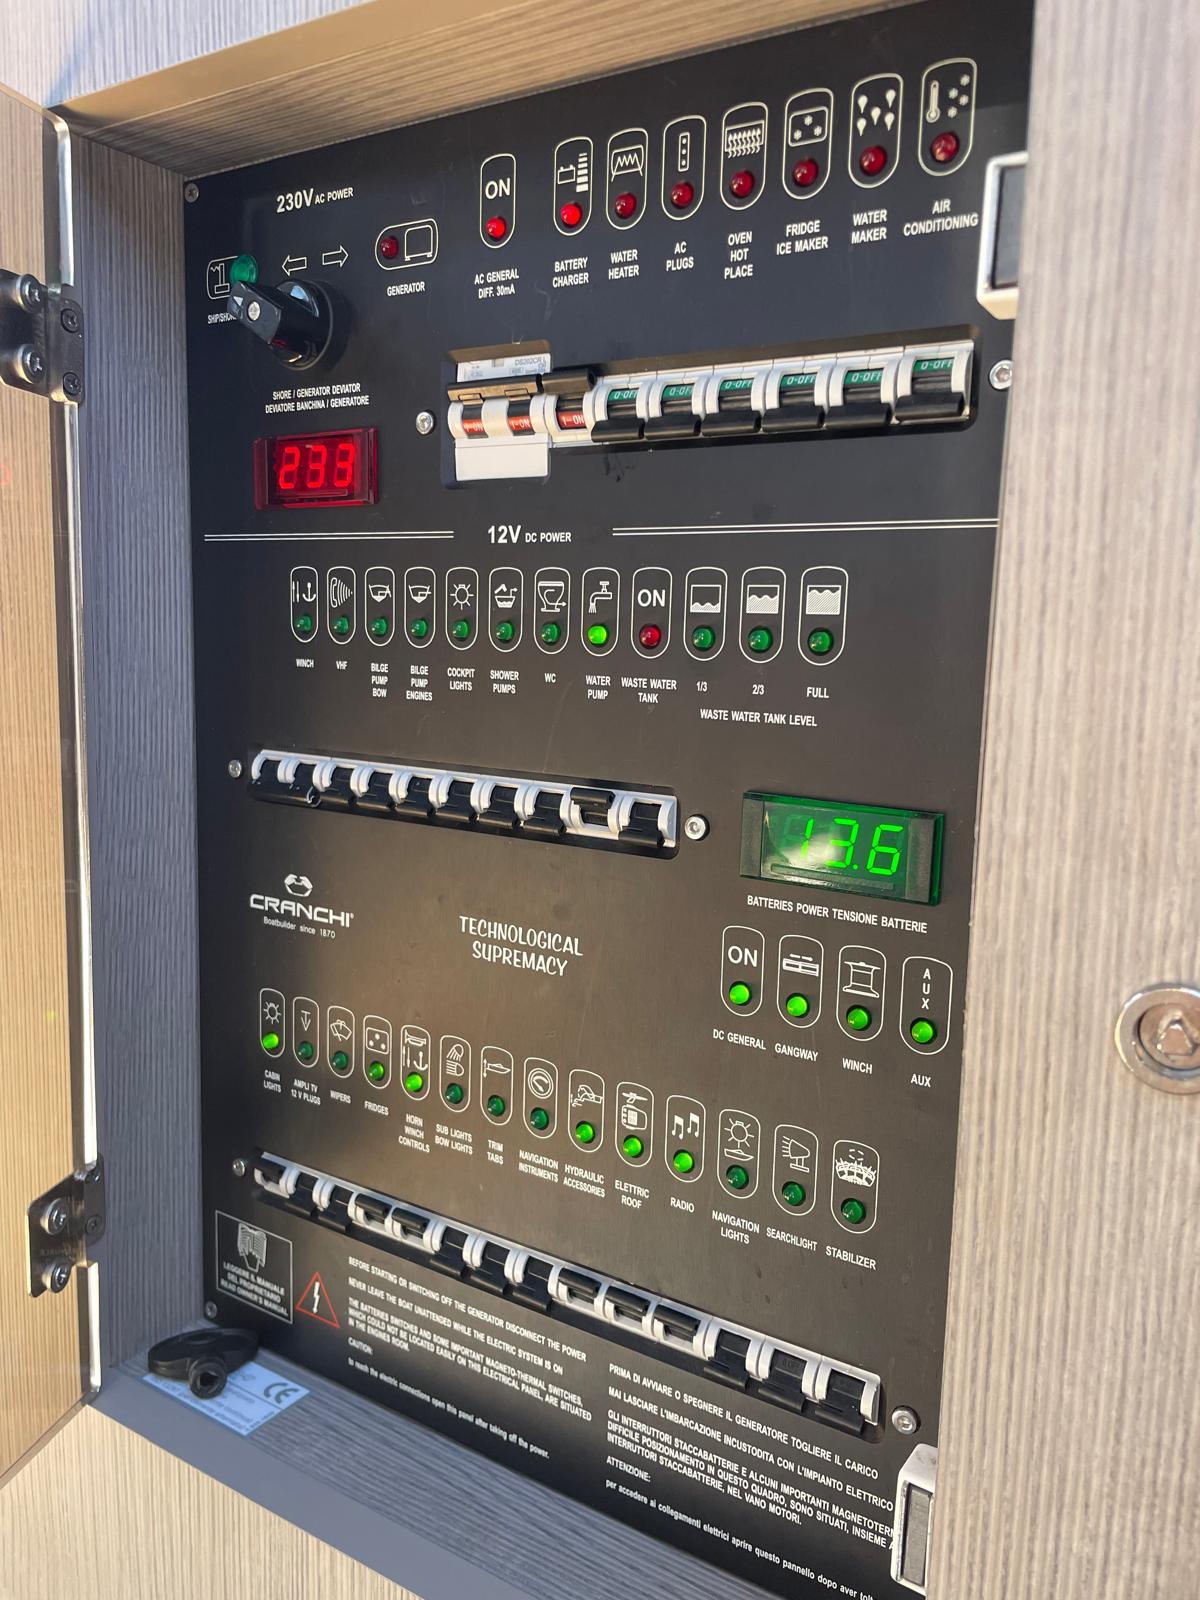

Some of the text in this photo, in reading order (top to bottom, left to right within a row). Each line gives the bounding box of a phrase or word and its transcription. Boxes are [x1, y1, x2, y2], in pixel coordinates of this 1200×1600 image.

[485, 178, 510, 200] ON
[277, 187, 353, 213] 230V AC POWER
[932, 199, 951, 214] AIR
[853, 209, 887, 226] WATER
[903, 213, 978, 236] CONDITIONING
[786, 220, 820, 237] FRIDGE
[851, 227, 887, 244] MAKER
[728, 231, 752, 246] OVEN
[776, 236, 828, 255] ICE MAKER
[674, 241, 686, 254] AC
[730, 248, 749, 261] HOT
[611, 249, 638, 264] WATER
[666, 256, 694, 271] PLUGS
[555, 257, 588, 272] BATTERY
[724, 264, 753, 279] PLACE
[475, 268, 519, 285] AC GENERAL
[553, 272, 589, 288] CHARGER
[608, 265, 639, 280] HEATER
[387, 282, 425, 296] GENERATOR
[478, 284, 515, 299] DIFF. 30mA
[273, 388, 292, 400] SHORE
[297, 385, 330, 397] GENERATOR
[332, 383, 360, 394] DEVIATOR
[265, 401, 294, 413] DEVIATORE
[296, 399, 325, 410] BANCHINA
[330, 395, 369, 408] GENERATORE
[279, 443, 356, 489] 233
[488, 525, 571, 544] 12V DC POWER
[637, 589, 665, 607] ON
[296, 658, 314, 668] WINCH
[336, 660, 347, 670] VHF
[371, 662, 389, 673] BILGE
[410, 665, 429, 676] BILGE
[371, 675, 388, 685] PUMP
[447, 667, 475, 678] COCKPIT
[490, 669, 519, 681] SHOWER
[544, 672, 556, 683] WC
[411, 678, 428, 688] PUMP
[450, 680, 472, 690] LIGHTS
[586, 675, 611, 686] WATER
[621, 677, 676, 690] WASTE WATER
[696, 681, 707, 692] 1/3
[373, 688, 387, 697] BOW
[406, 690, 432, 701] ENGINES
[493, 683, 515, 694] PUMPS
[588, 689, 608, 700] PUMP
[752, 684, 764, 695] 2/3
[807, 687, 829, 699] FULL
[638, 692, 658, 704] TANK
[700, 708, 817, 726] WASTE WATER TANK LEVEL
[801, 818, 903, 876] 13.6
[747, 895, 927, 933] BATTERIES POWER TENSIONE BATTERIE
[264, 916, 335, 939] Boatbuilder since 1870
[459, 916, 583, 956] TECHNOLOGICAL
[472, 941, 568, 976] SUPREMACY
[728, 946, 758, 967] ON
[713, 1028, 766, 1050] DC GENERAL
[775, 1042, 818, 1062] GANGWAY
[842, 1058, 872, 1074] WINCH
[264, 1069, 280, 1082] CABIN
[911, 1073, 931, 1088] AUX
[264, 1080, 281, 1093] LIGHTS
[294, 1079, 318, 1093] AMPLI TV
[291, 1089, 321, 1105] 12 V PLUGS
[330, 1090, 351, 1104] WIPERS
[365, 1101, 388, 1115] FRIDGES
[406, 1113, 423, 1127] HORN
[404, 1126, 424, 1139] WINCH
[436, 1124, 472, 1142] SUB LIGHTS
[399, 1135, 430, 1153] CONTROLS
[435, 1136, 472, 1155] BOW LIGHTS
[488, 1140, 503, 1151] TRIM
[487, 1152, 503, 1164] TABS
[520, 1150, 558, 1169] NAVIGATION
[519, 1163, 558, 1182] INSTRUMENTS
[565, 1164, 604, 1184] HYDRAULIC
[563, 1177, 605, 1198] ACCESSORIES
[615, 1180, 649, 1198] ELETTRIC
[621, 1195, 642, 1209] ROOF
[671, 1197, 694, 1213] RADIO
[712, 1210, 759, 1233] NAVIGATION
[721, 1227, 750, 1245] LIGHTS
[766, 1227, 817, 1251] SEARCHLIGHT
[826, 1246, 876, 1270] STABILIZER
[349, 1256, 586, 1362] BEFORE STARTING OR SWITCHING OFF THE GENERATOR DISCONNECT THE POWER
[610, 1363, 878, 1480] PRIMA DI AVVIARE O SPEGNERE IL GENERATORE TOGLIERE IL CARICO
[608, 1386, 893, 1511] MAI LASCIARE L'IMBARCAZIONE INCUSTODITA CON L'IMPIANTO ELETTRICO
